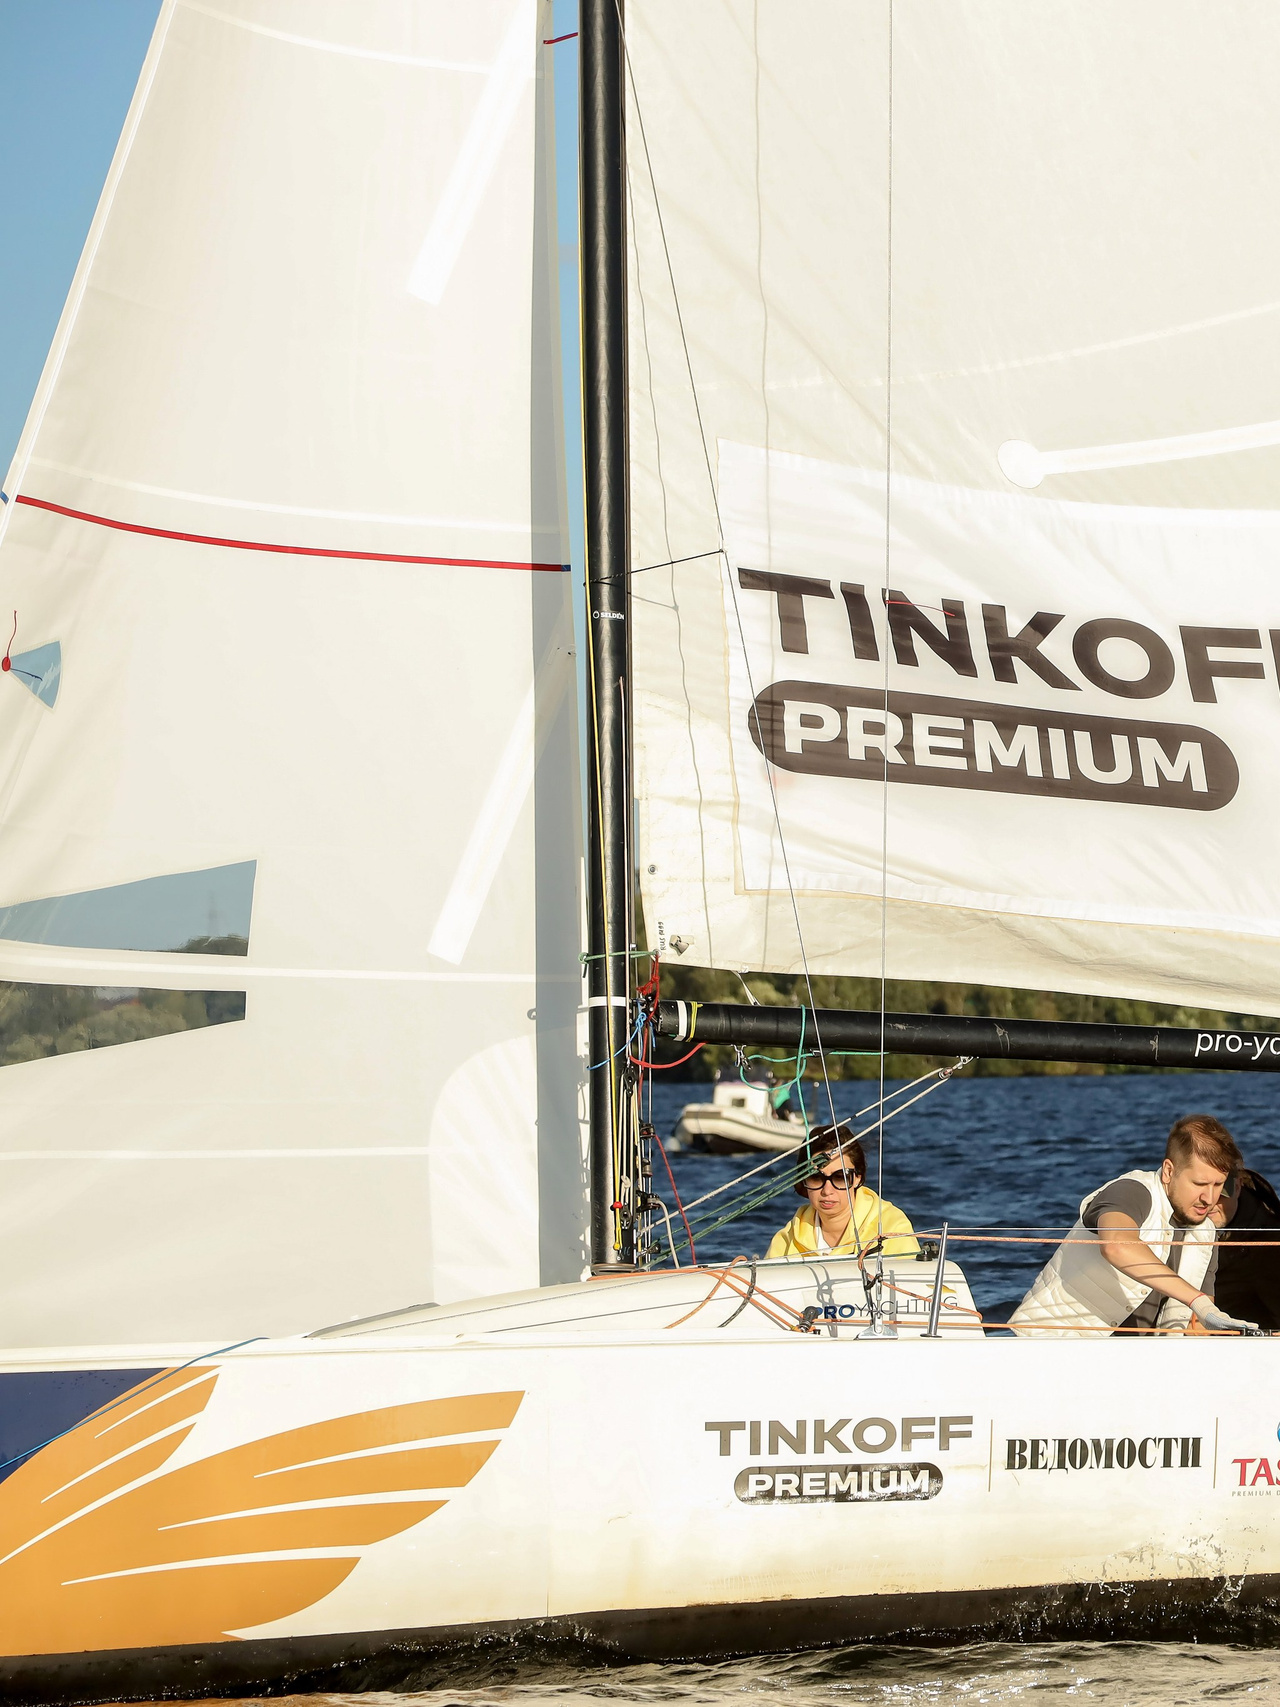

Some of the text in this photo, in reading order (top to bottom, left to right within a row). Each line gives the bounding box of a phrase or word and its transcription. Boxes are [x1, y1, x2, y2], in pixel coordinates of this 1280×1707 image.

[783, 699, 1210, 793] PREMIUM
[705, 1416, 973, 1456] TINKOFF
[1005, 1437, 1202, 1474] ВЕДОМОСТИ
[748, 1469, 930, 1498] PREMIUM
